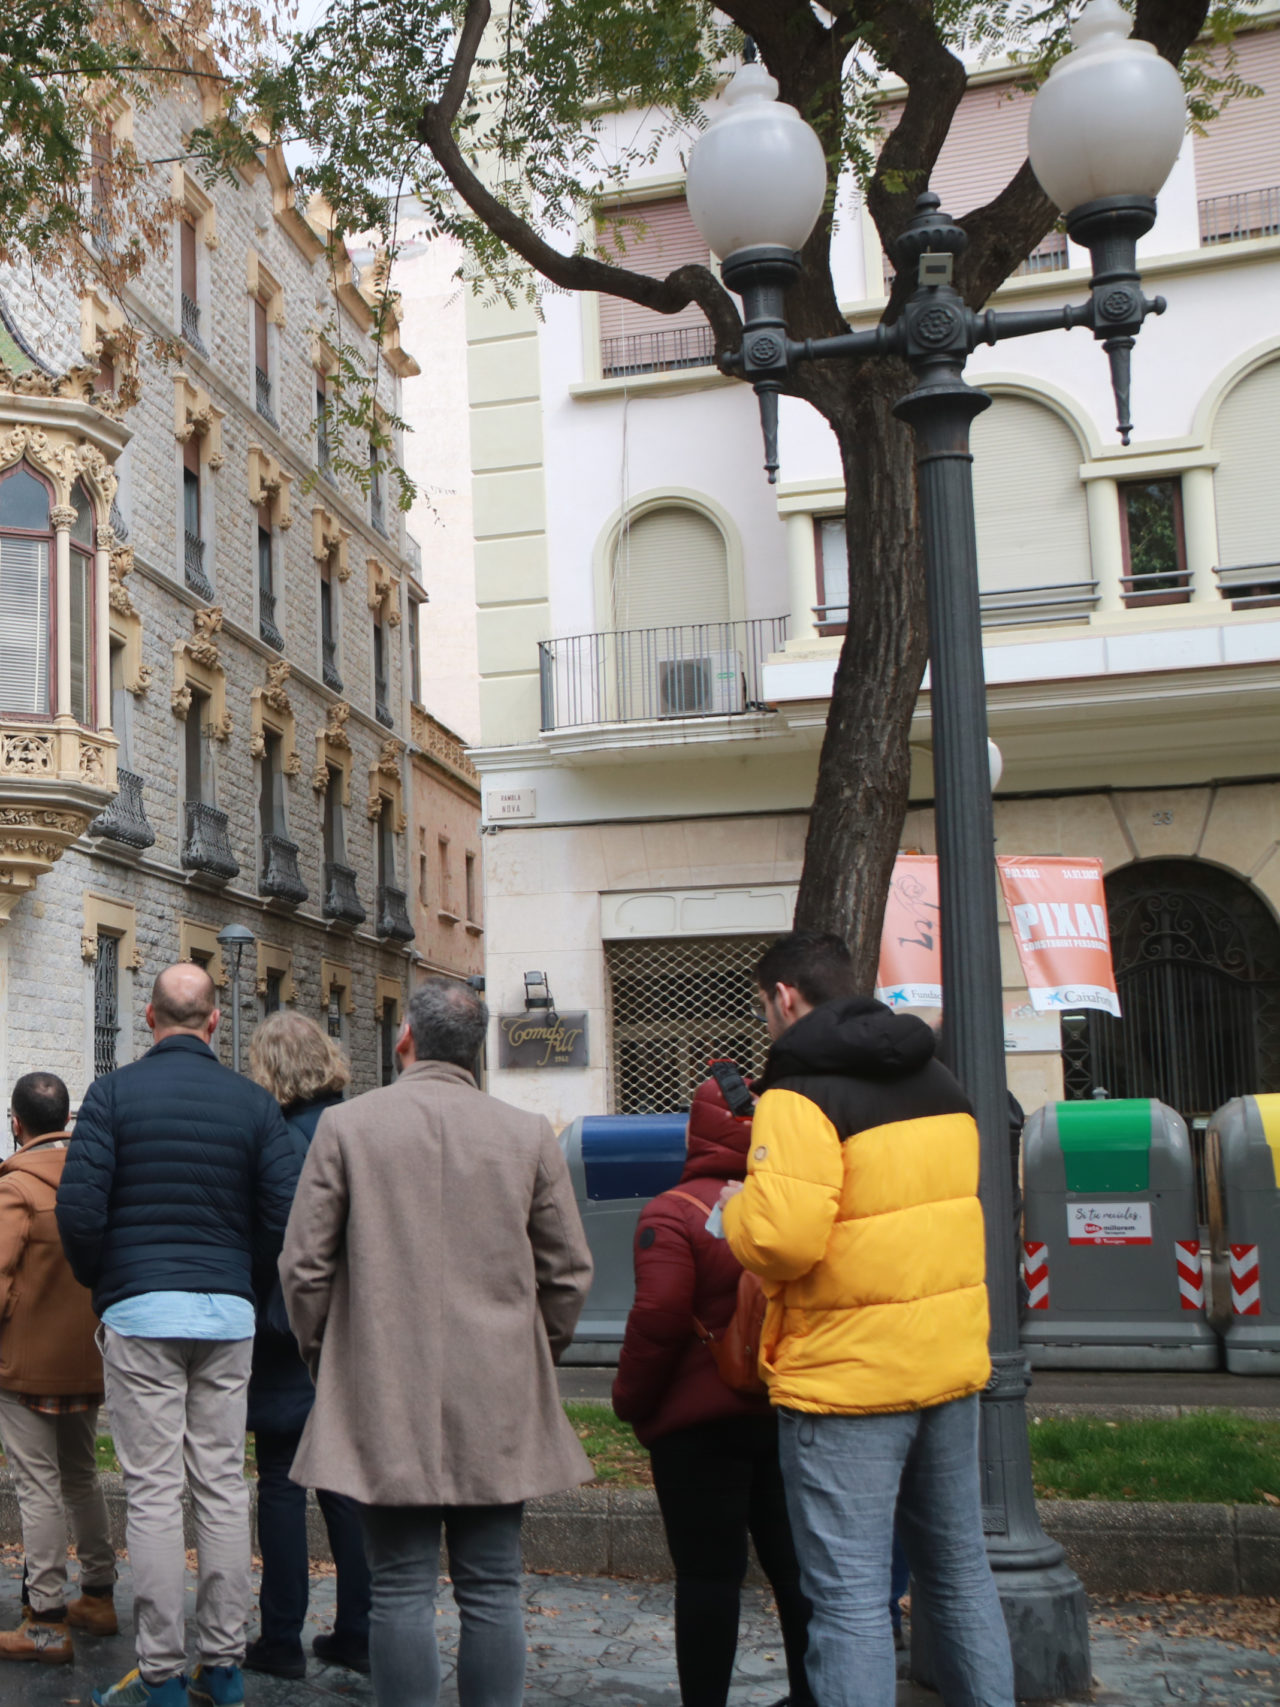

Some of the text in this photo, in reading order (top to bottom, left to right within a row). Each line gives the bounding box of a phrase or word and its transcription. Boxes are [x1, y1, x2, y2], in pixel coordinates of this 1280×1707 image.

[501, 804, 521, 812] NOVA
[1152, 810, 1174, 825] 23
[1075, 1208, 1086, 1220] Si
